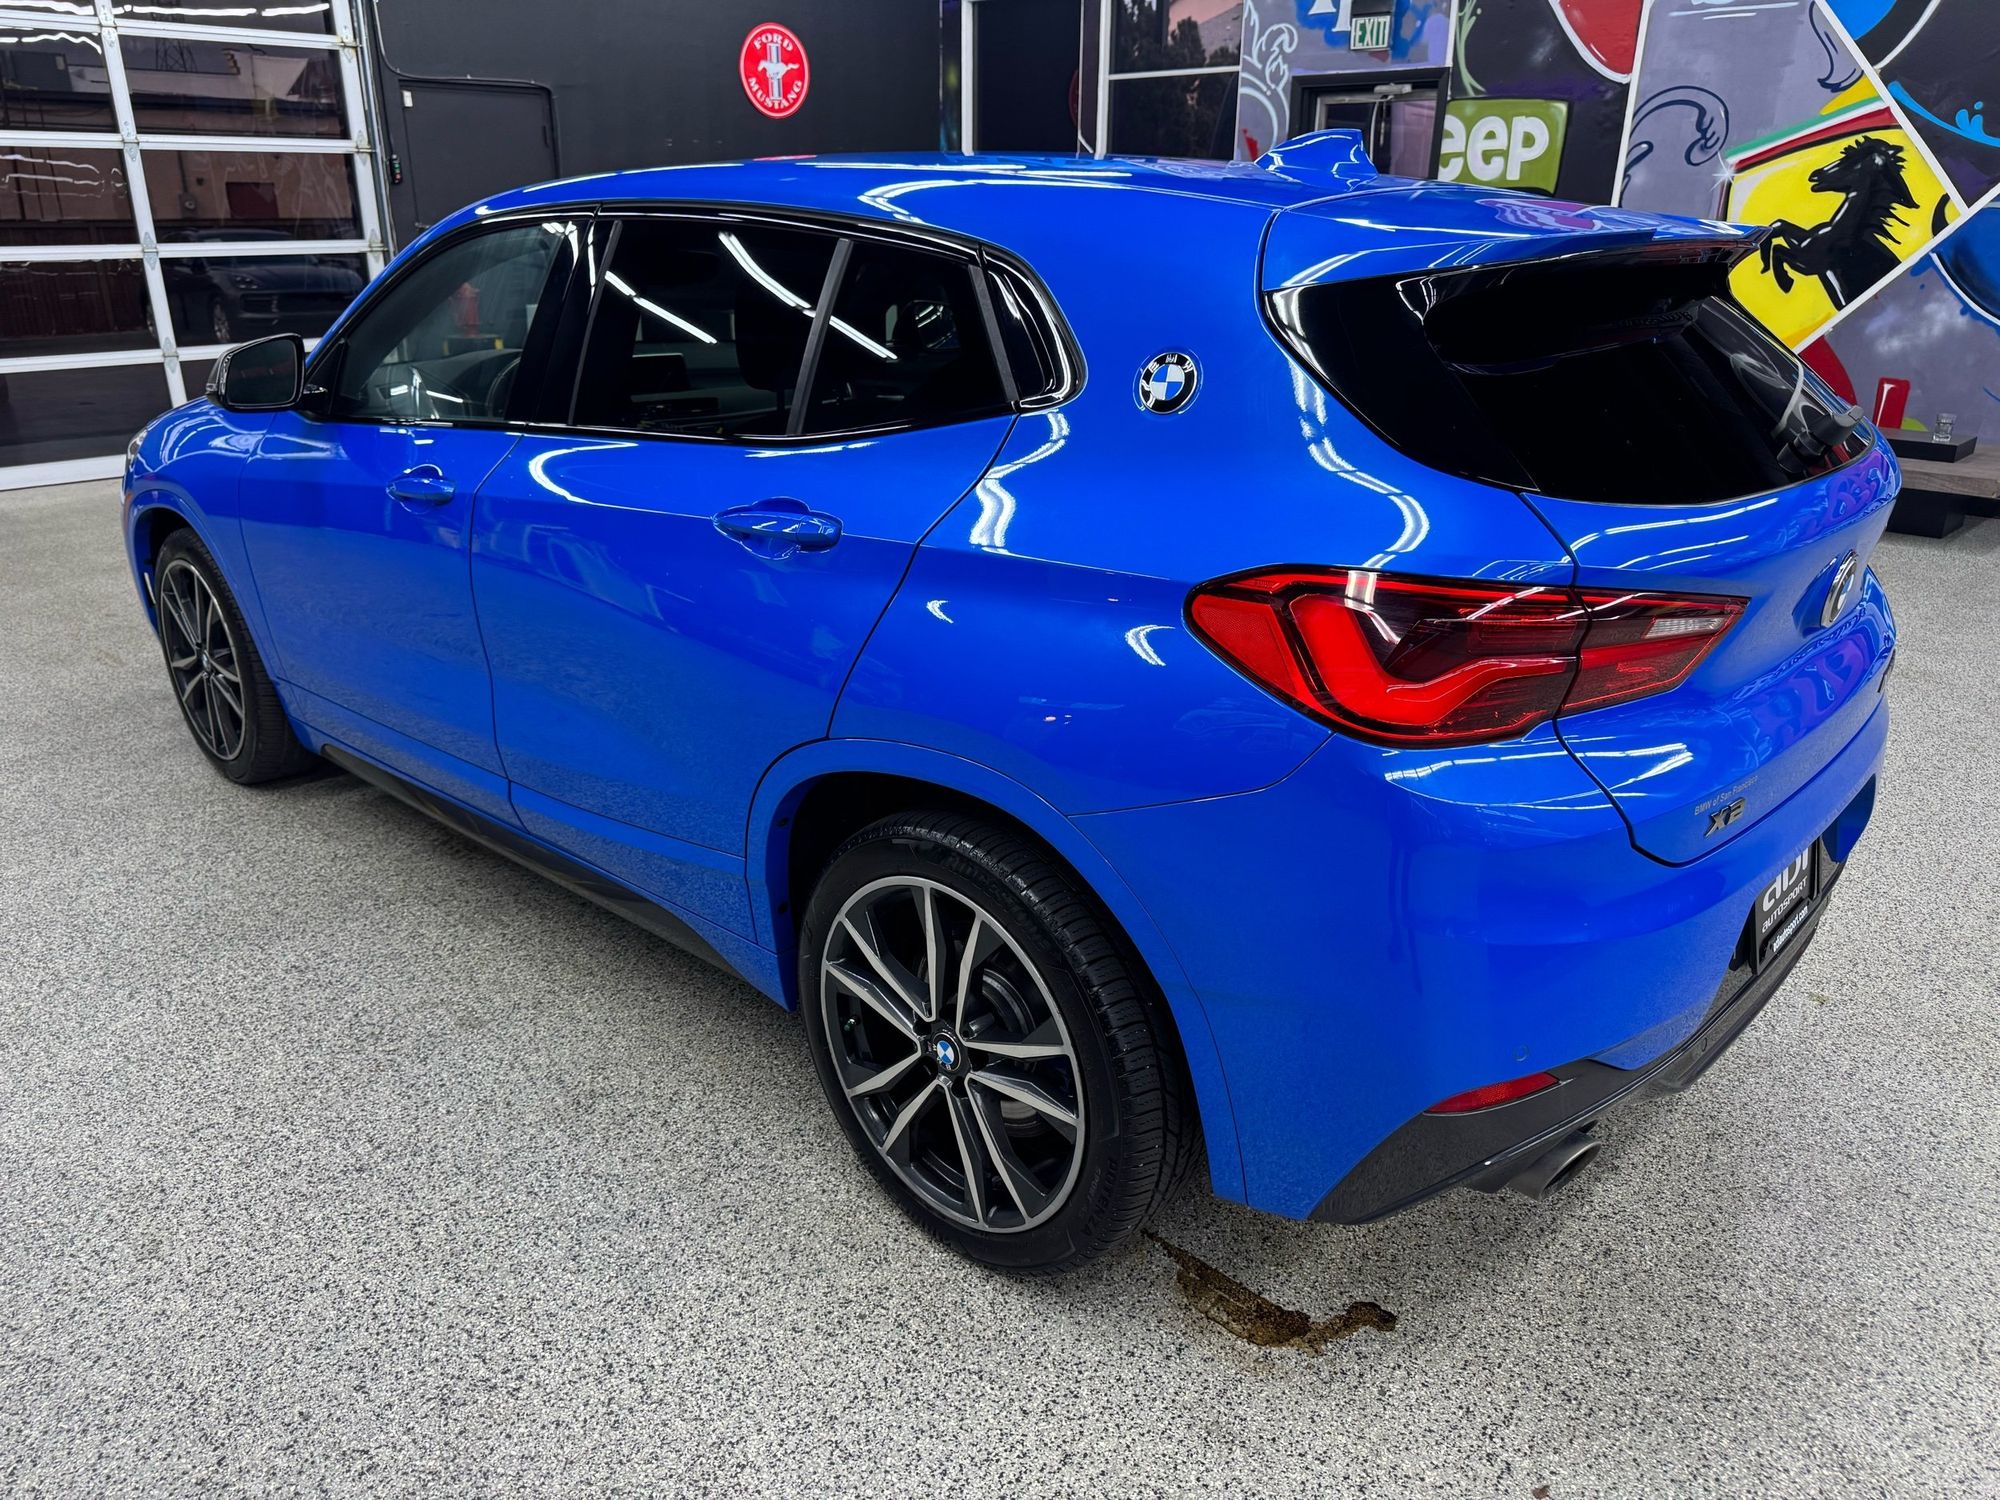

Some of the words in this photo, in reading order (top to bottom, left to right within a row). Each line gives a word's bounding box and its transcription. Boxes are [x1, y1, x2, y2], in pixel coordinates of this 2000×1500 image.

[753, 33, 793, 51] FORD
[1355, 18, 1387, 47] EXIT
[748, 77, 802, 109] MUSTANG
[1438, 114, 1550, 181] eep
[1694, 800, 1712, 816] BMW
[1713, 794, 1720, 806] of
[1720, 791, 1732, 802] San
[1704, 797, 1745, 838] X2
